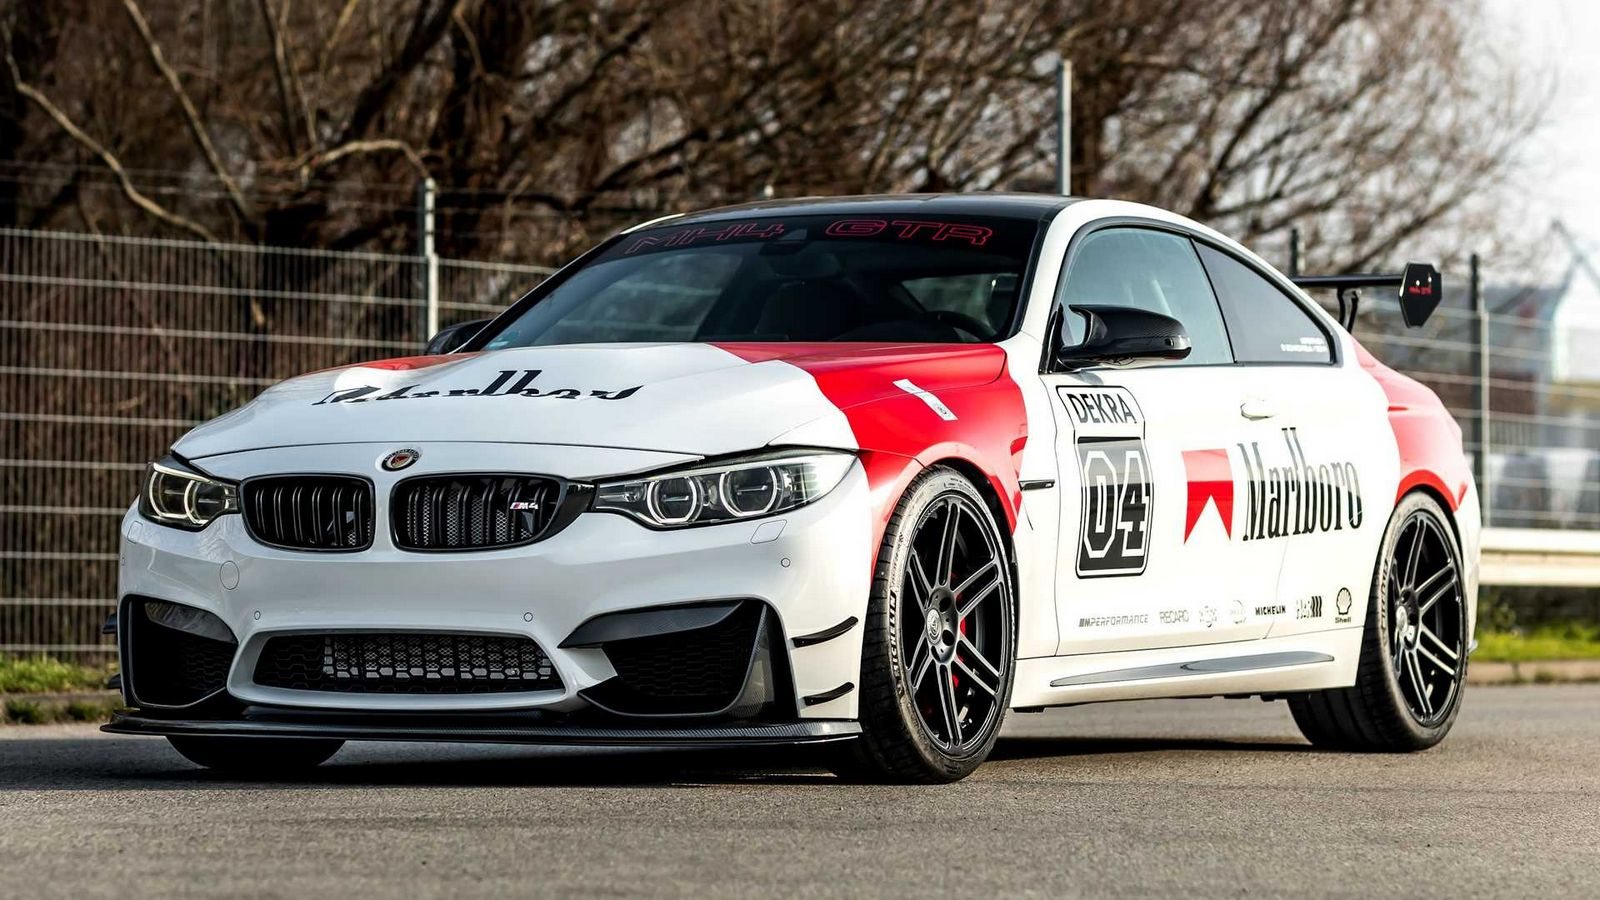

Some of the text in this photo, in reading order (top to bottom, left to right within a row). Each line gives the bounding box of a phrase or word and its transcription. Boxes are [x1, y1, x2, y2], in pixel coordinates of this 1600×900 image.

[625, 219, 993, 254] MH4 GTR
[1067, 393, 1137, 424] DEKRA
[1236, 427, 1363, 541] Marlboro
[513, 502, 539, 510] M4
[1083, 451, 1149, 558] 04
[1159, 609, 1190, 624] RECARO
[1255, 605, 1286, 616] MICHELIN
[1335, 616, 1352, 624] Shell
